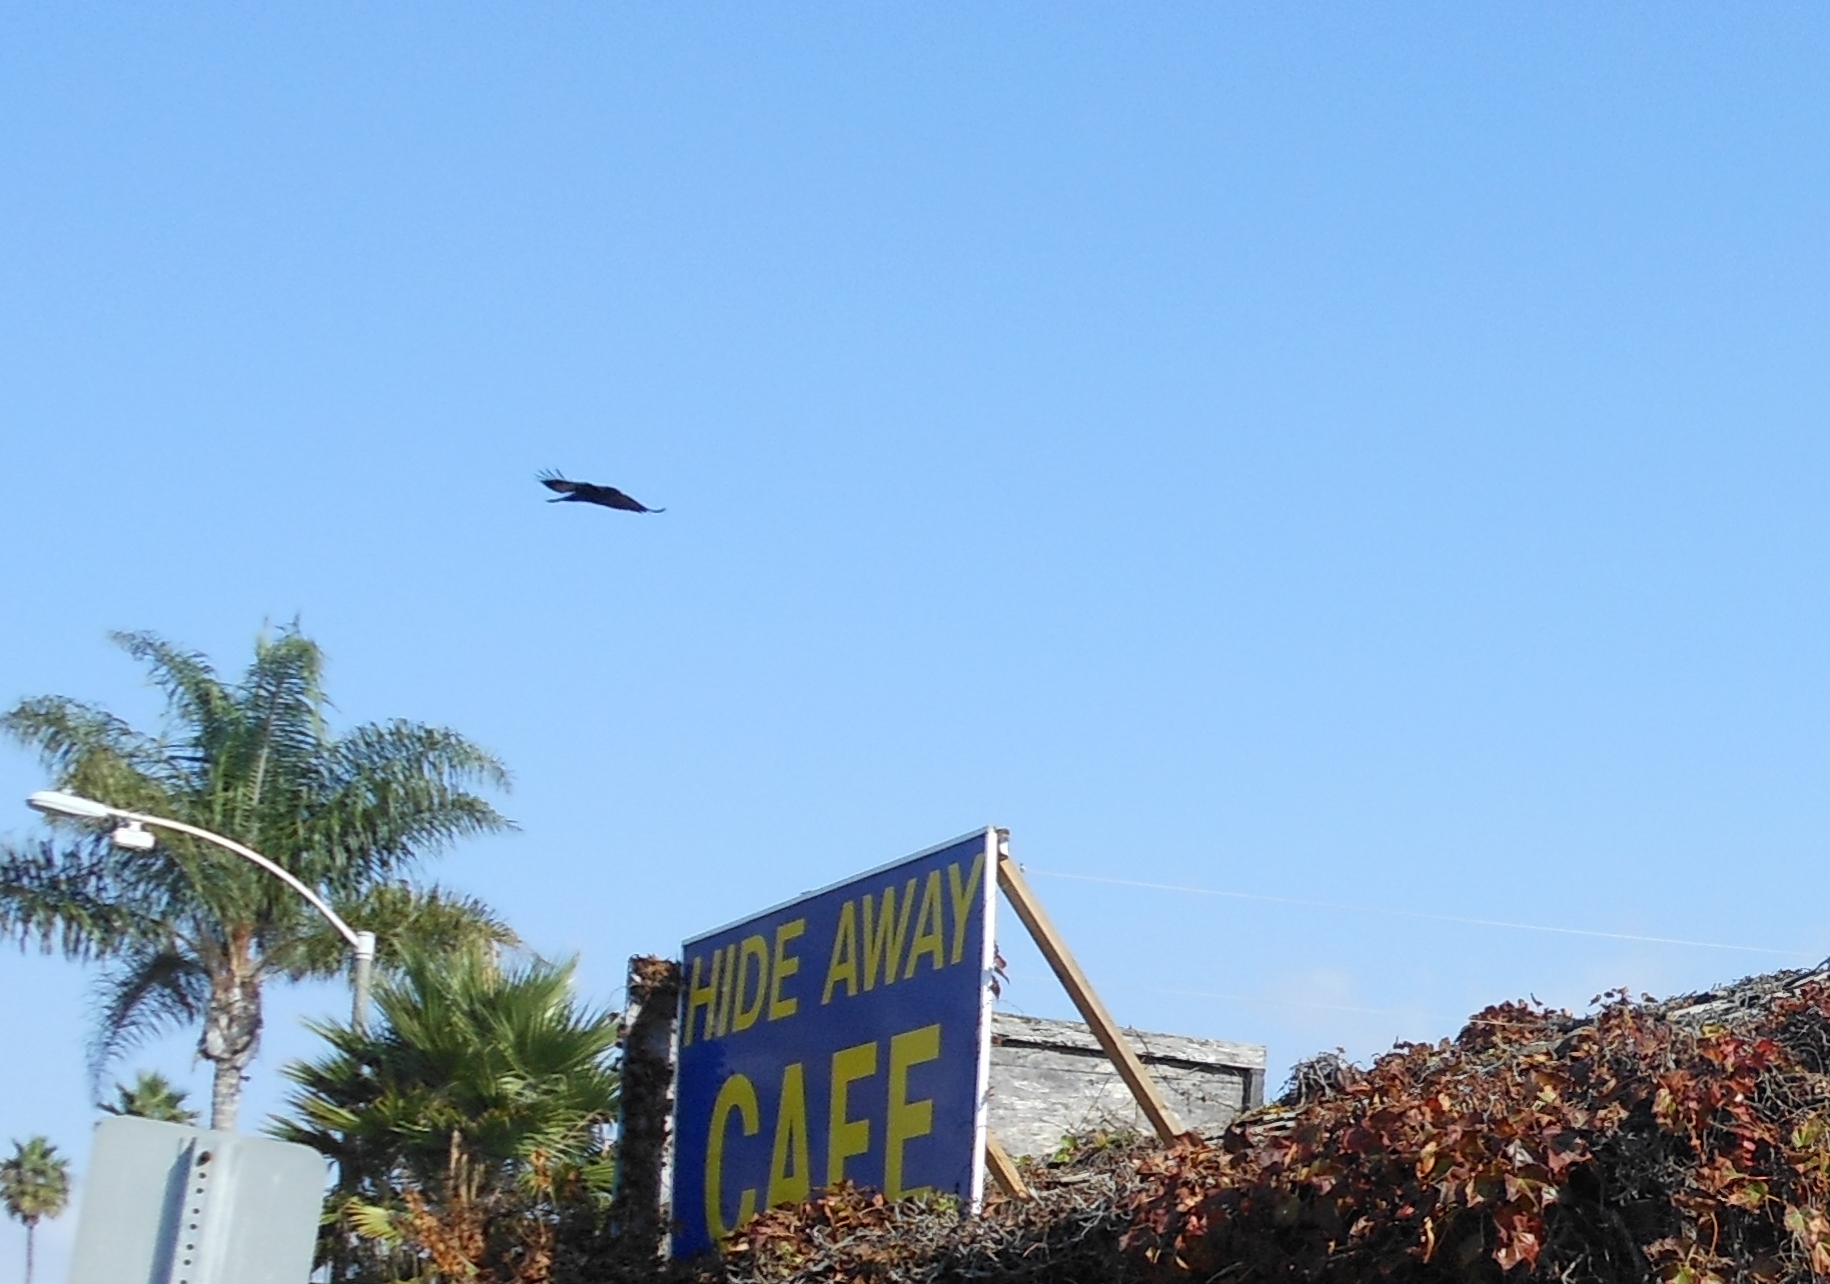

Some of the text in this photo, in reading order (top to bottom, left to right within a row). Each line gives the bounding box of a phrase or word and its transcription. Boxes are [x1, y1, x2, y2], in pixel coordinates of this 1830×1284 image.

[682, 853, 985, 1046] HIDE AWAY
[704, 1023, 941, 1251] CAFE
